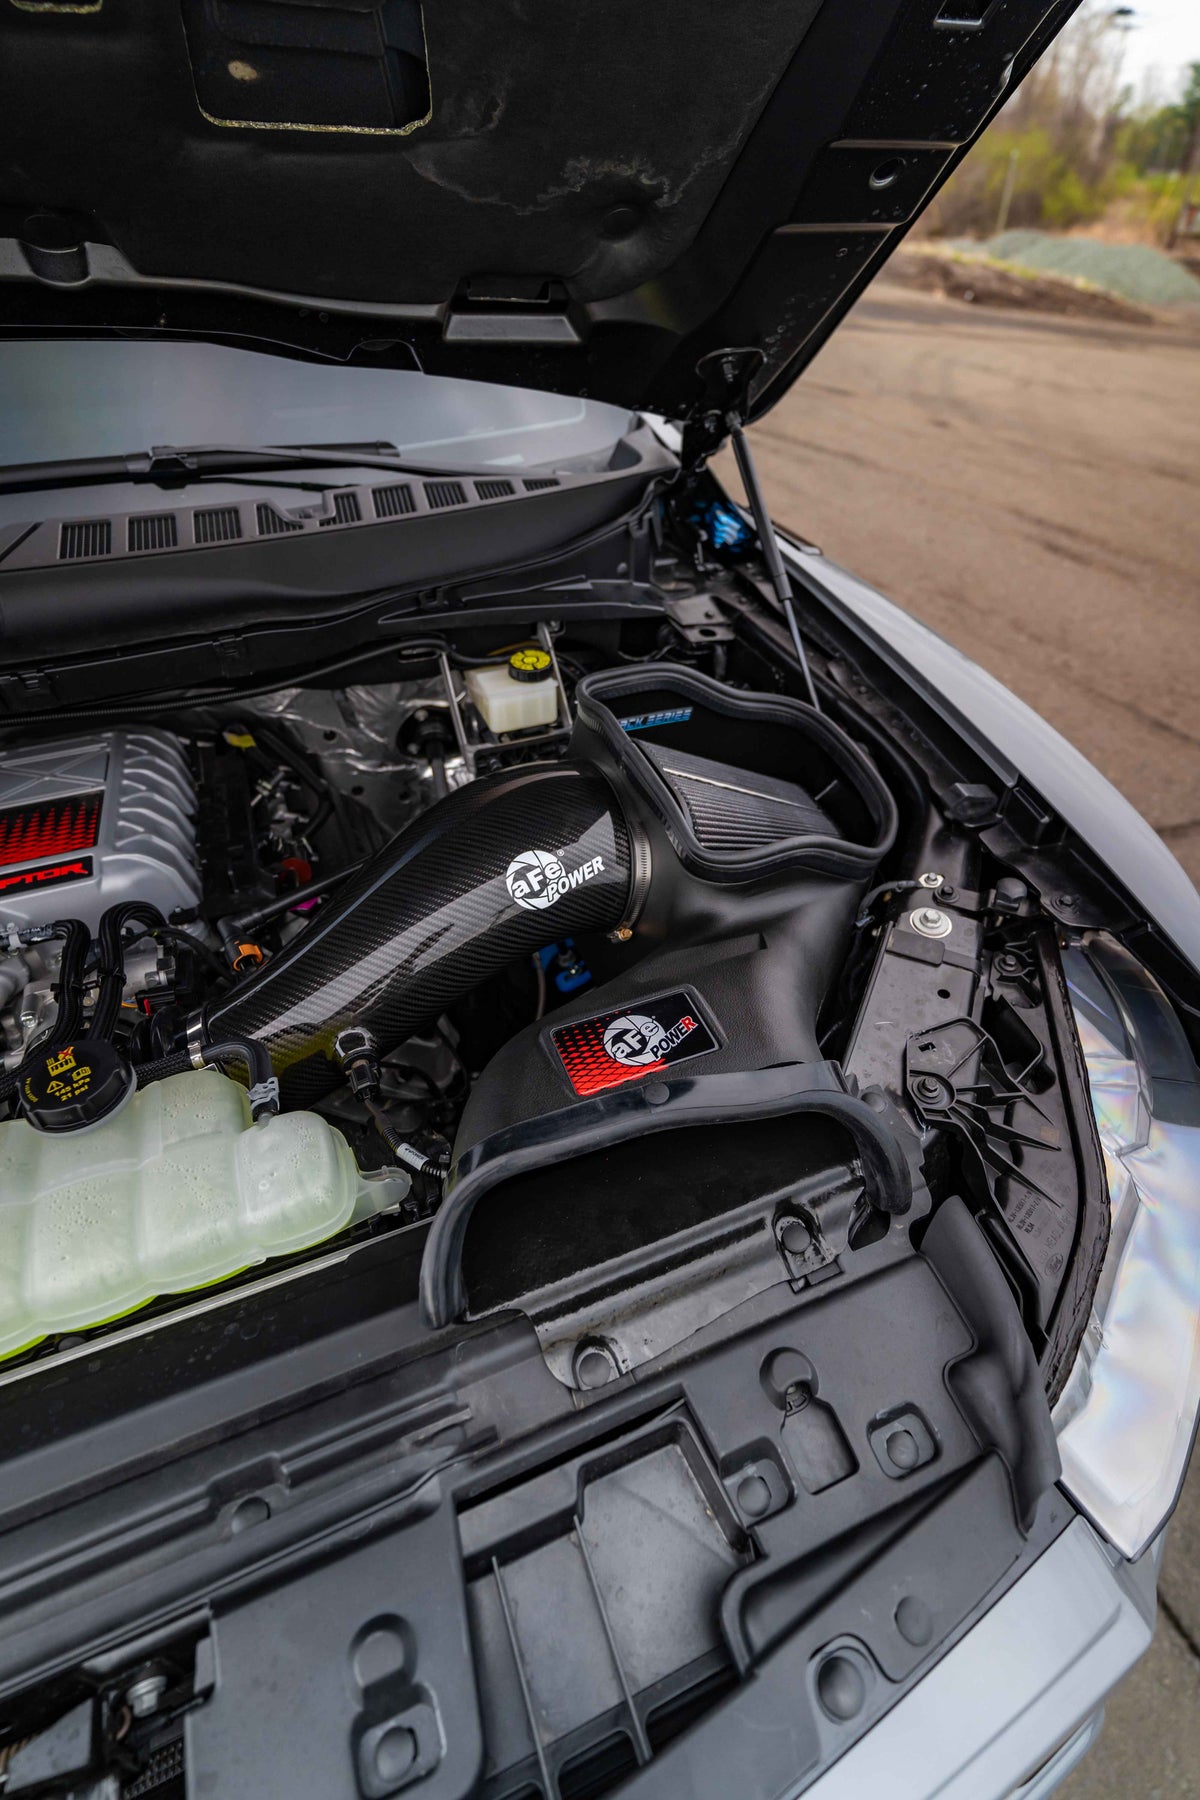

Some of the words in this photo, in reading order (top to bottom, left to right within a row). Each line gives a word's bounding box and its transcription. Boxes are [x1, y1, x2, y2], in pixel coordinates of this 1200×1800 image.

[648, 708, 692, 727] SERIES
[511, 861, 561, 898] aFe
[547, 856, 605, 901] POWER
[612, 1021, 660, 1059] aFe
[650, 1016, 699, 1061] POWER
